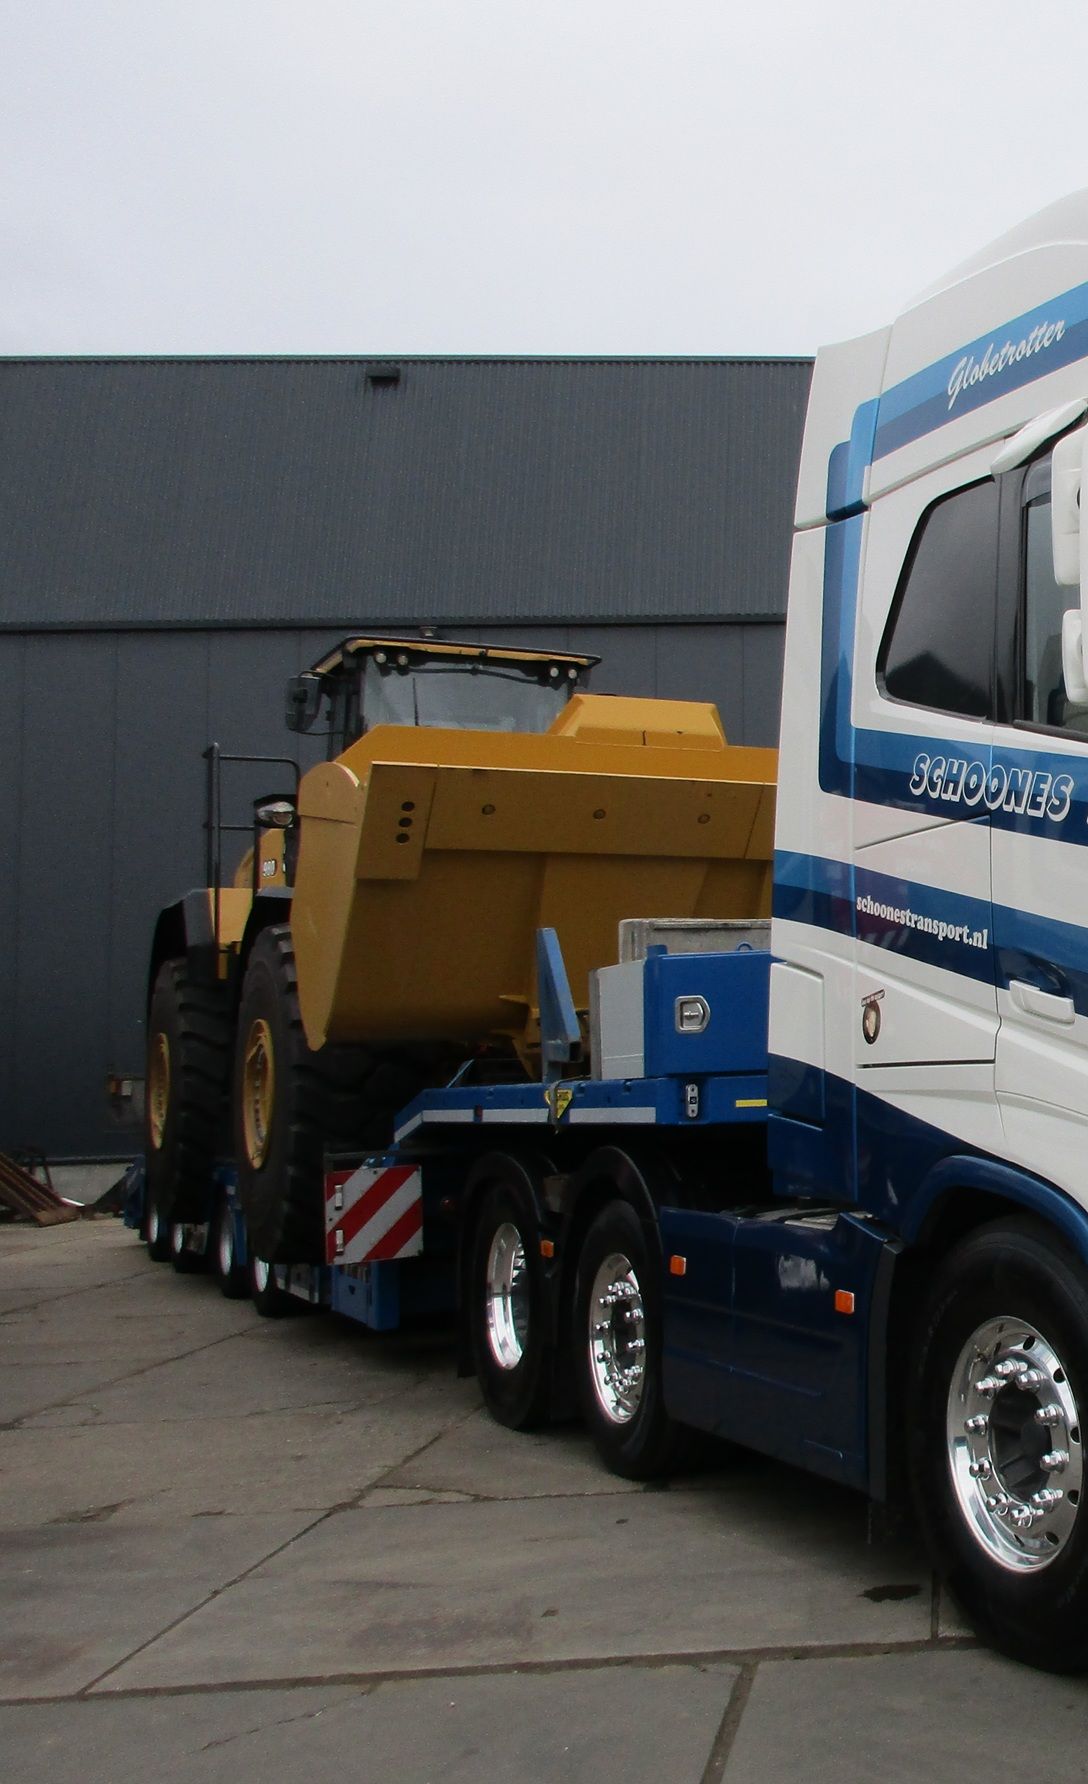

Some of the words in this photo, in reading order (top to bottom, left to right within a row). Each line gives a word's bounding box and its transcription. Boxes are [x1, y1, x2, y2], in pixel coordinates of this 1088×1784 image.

[947, 319, 1066, 410] Globetrotter
[909, 753, 1074, 822] SCHOONES
[856, 894, 988, 950] schoonestransport.nl
